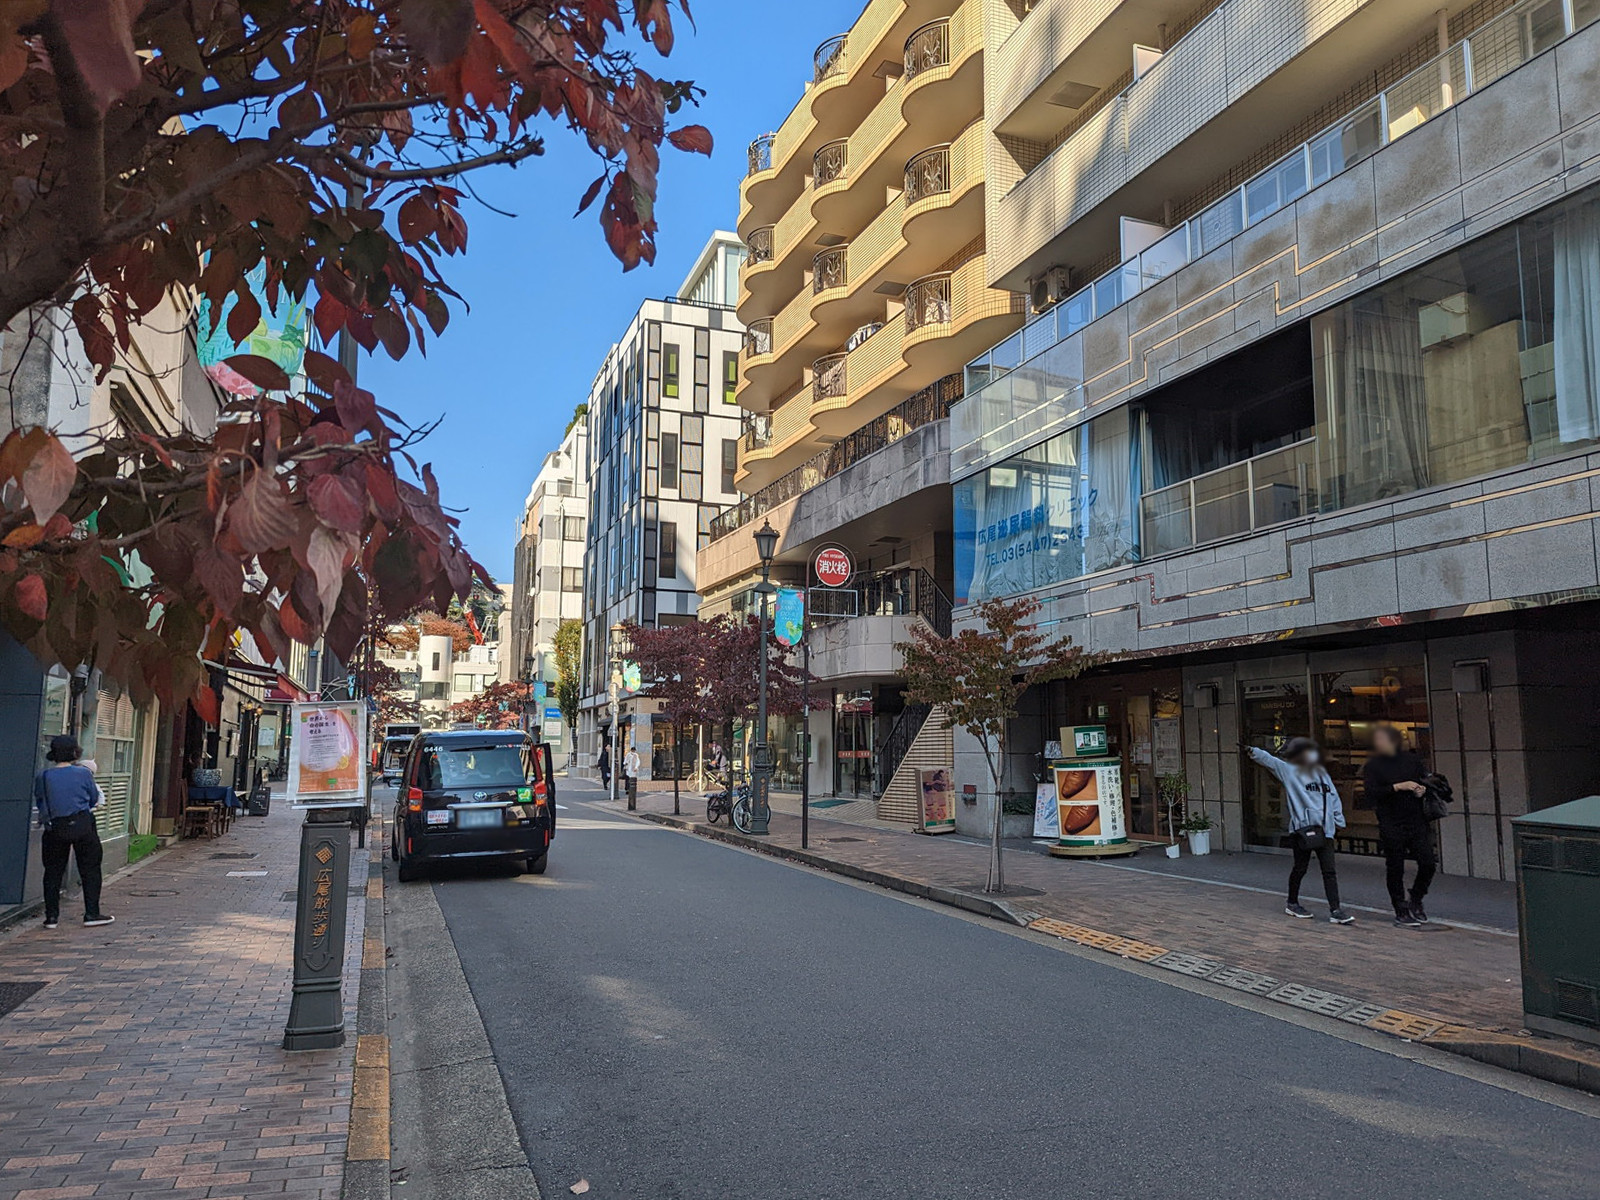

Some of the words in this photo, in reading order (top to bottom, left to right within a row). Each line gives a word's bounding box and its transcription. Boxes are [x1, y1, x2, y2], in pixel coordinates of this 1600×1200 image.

[977, 488, 1098, 546] 広尾泌尿器科クリニック
[819, 559, 848, 576] 消火栓
[312, 868, 333, 949] 広尾散歩通り
